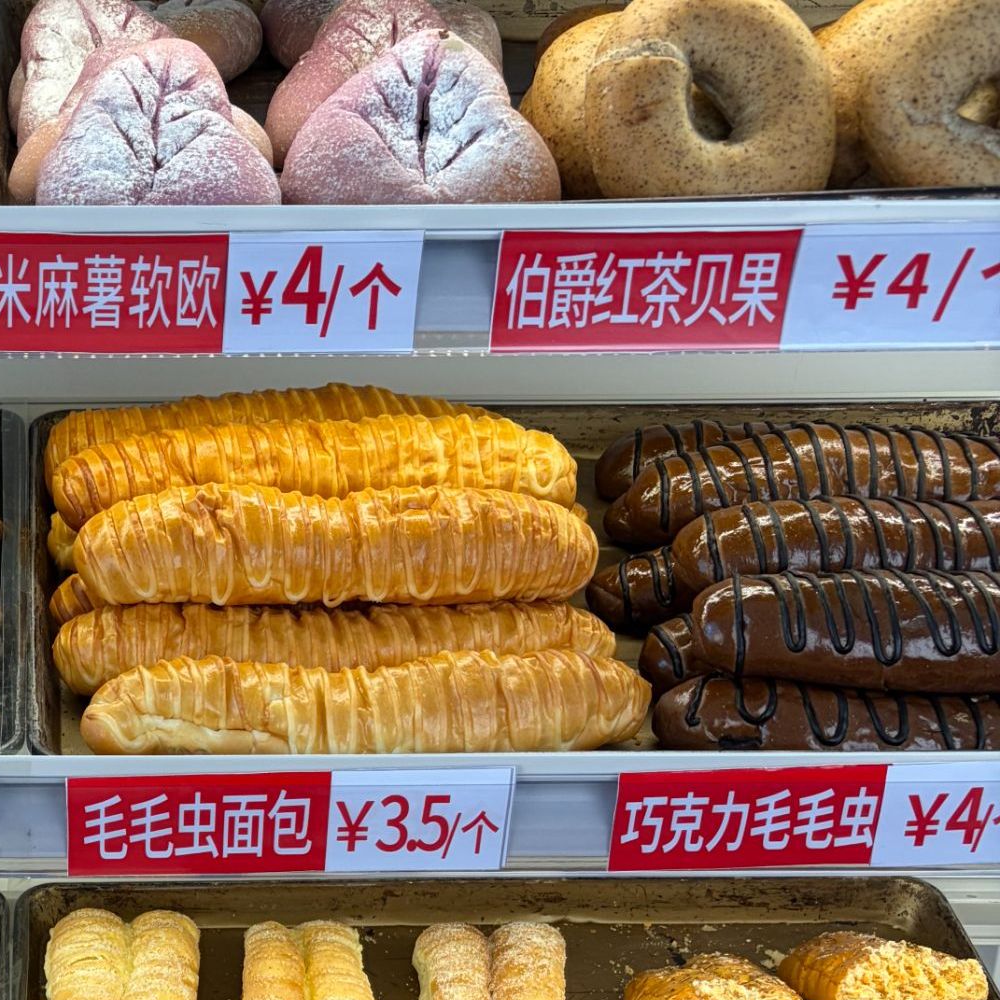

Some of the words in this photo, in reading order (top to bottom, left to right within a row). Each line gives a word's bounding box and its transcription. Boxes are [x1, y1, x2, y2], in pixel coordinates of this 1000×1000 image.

[506, 252, 782, 329] 伯爵红茶贝果
[84, 790, 311, 859] 毛毛虫面包
[620, 786, 878, 853] 巧克力毛毛虫
[905, 788, 1000, 852] ¥4/
